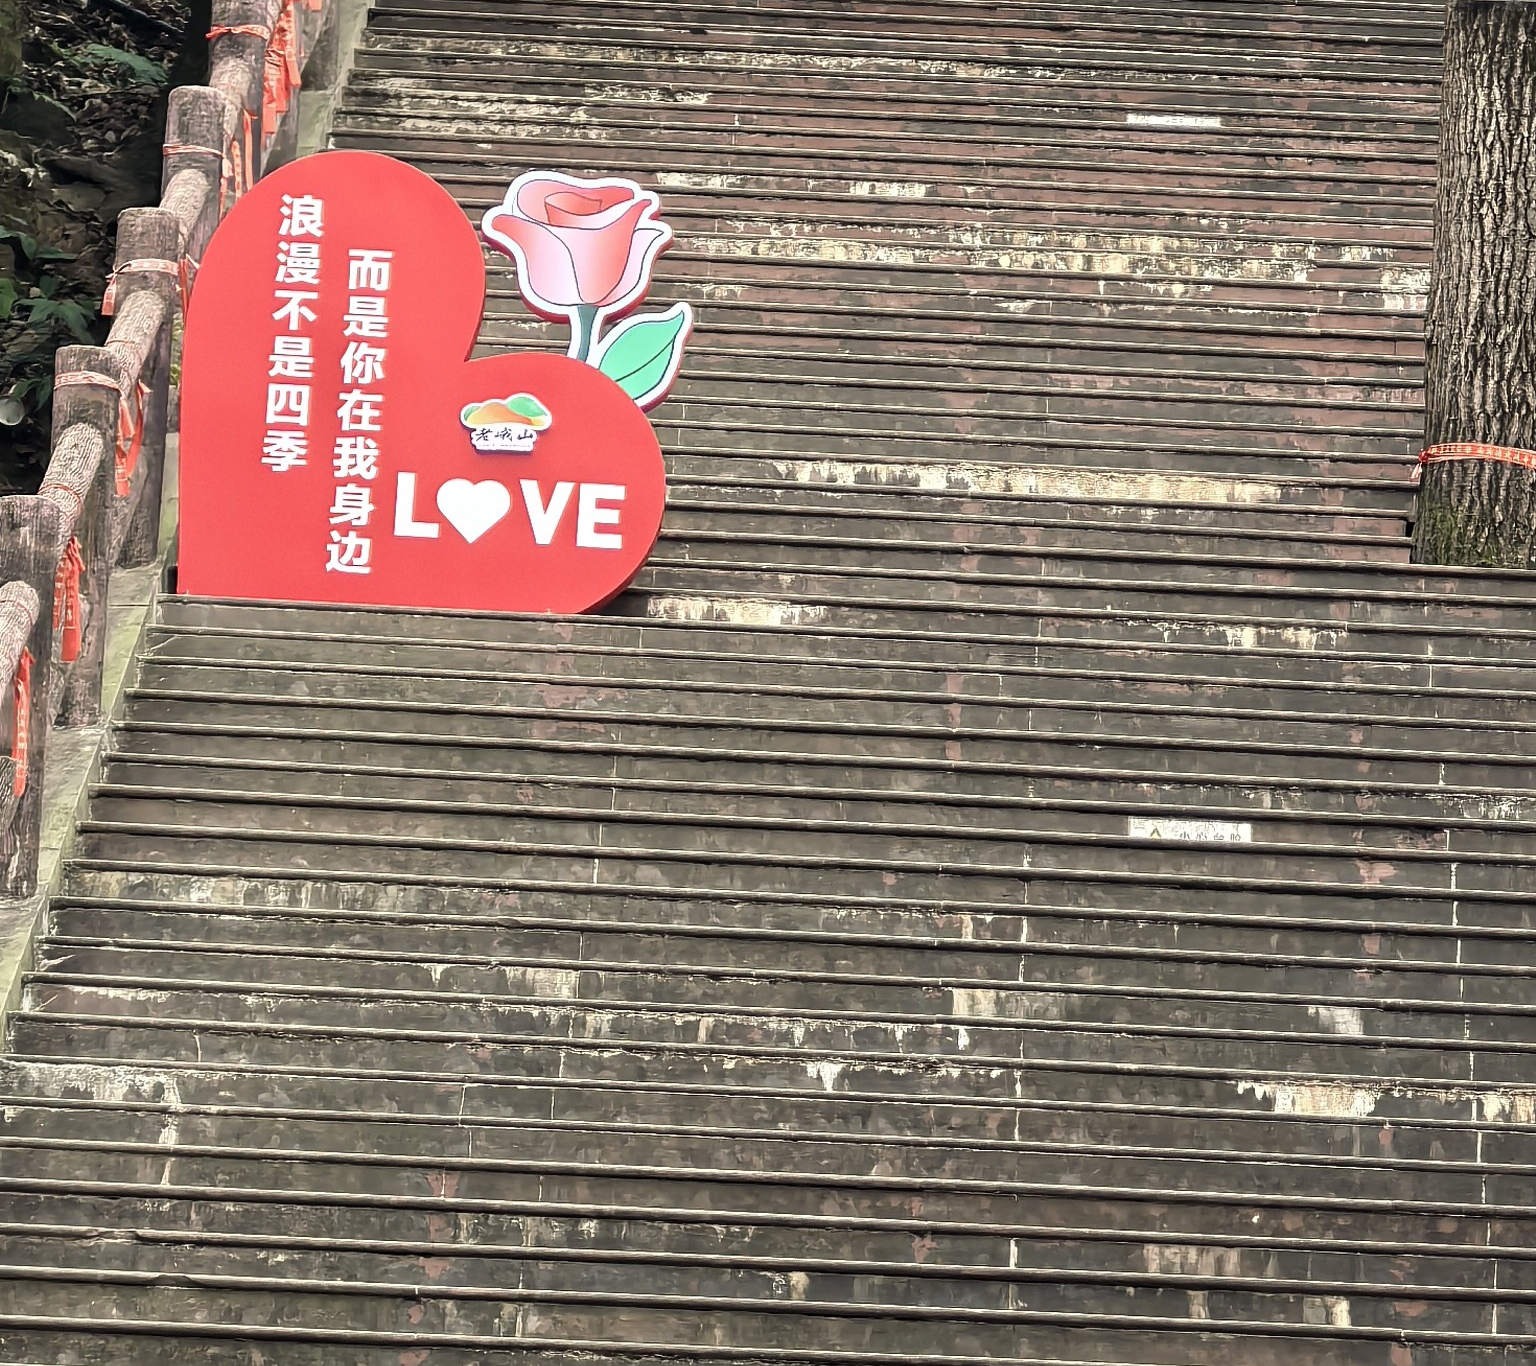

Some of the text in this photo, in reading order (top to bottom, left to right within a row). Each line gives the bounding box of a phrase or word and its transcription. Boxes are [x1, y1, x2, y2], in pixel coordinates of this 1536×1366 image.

[261, 193, 324, 472] 浪漫不是四季
[326, 248, 393, 574] 而是你在我身边
